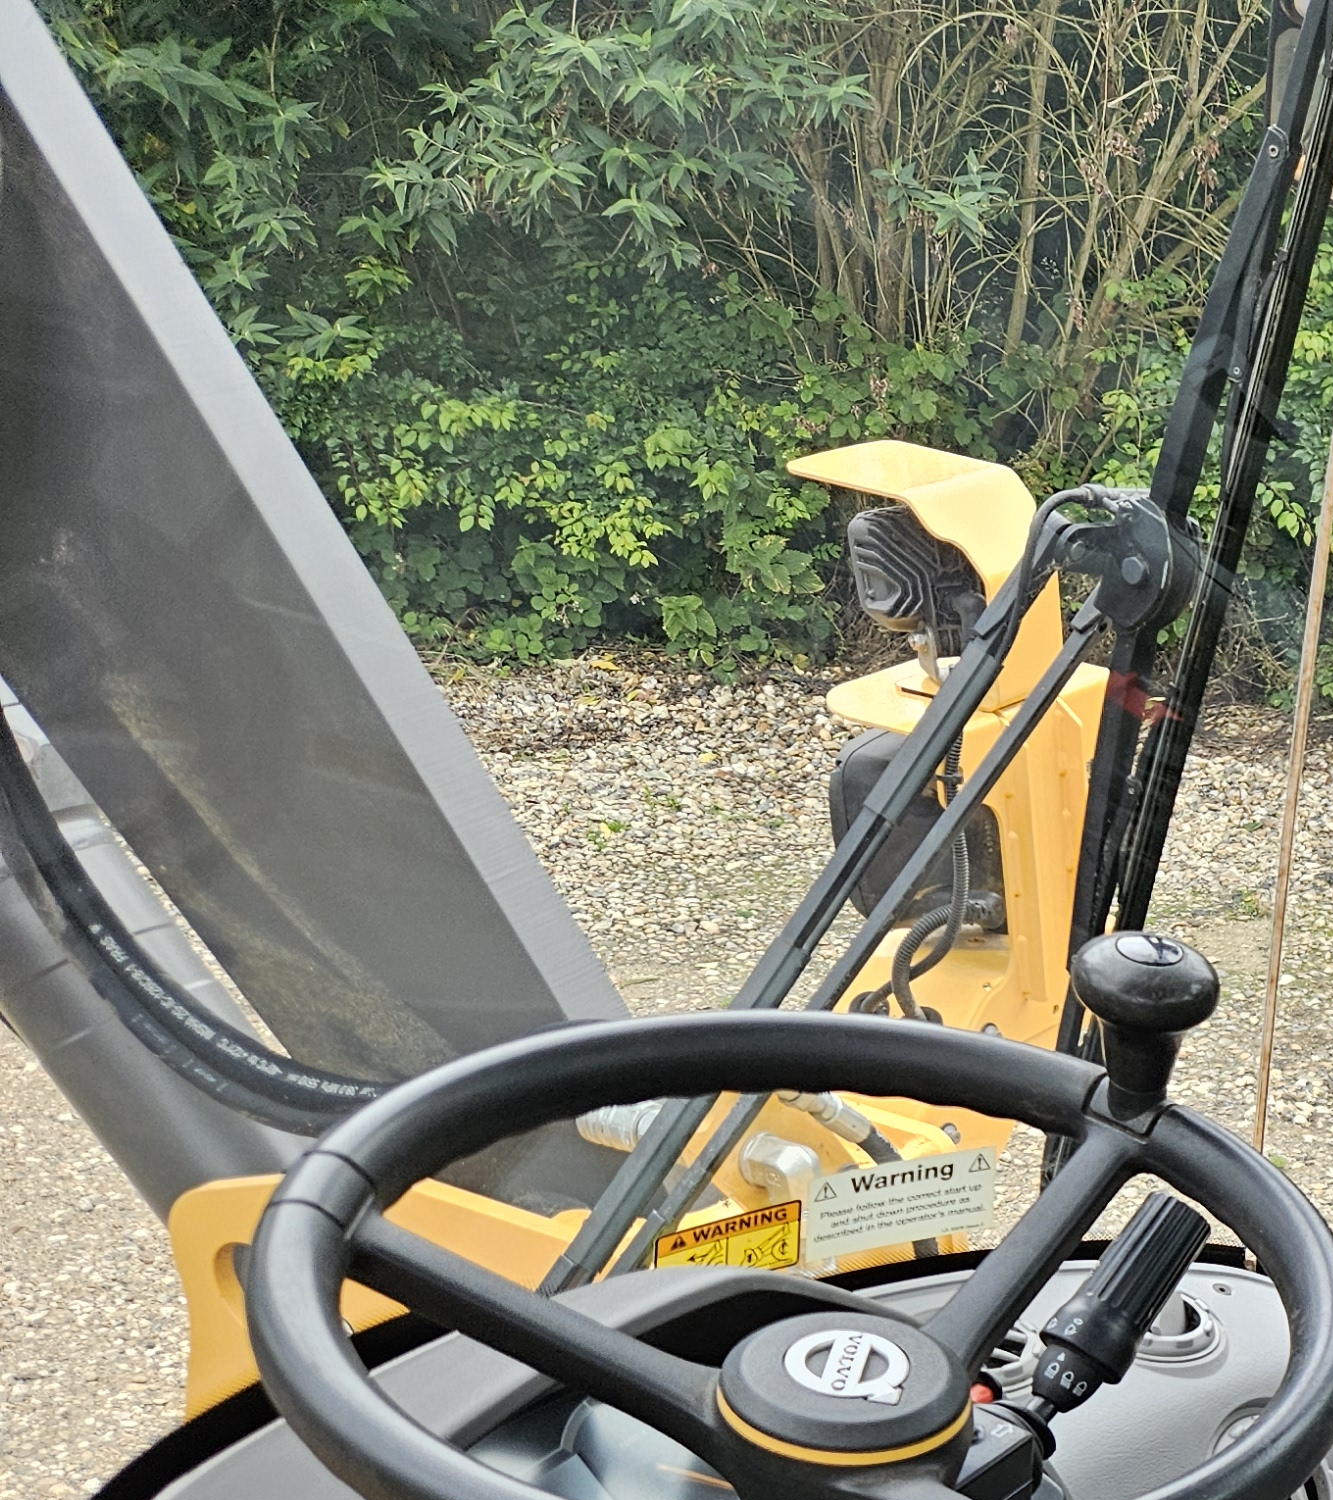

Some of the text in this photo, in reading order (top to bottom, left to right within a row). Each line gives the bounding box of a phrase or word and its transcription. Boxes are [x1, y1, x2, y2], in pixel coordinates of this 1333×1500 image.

[851, 1163, 954, 1193] Warning
[888, 1195, 903, 1206] the
[944, 1185, 966, 1197] start
[969, 1183, 982, 1194] up
[692, 1208, 788, 1243] WARNING
[830, 1218, 850, 1228] and
[865, 1223, 875, 1231] in
[877, 1219, 894, 1229] the
[830, 1334, 864, 1391] VOLVO
